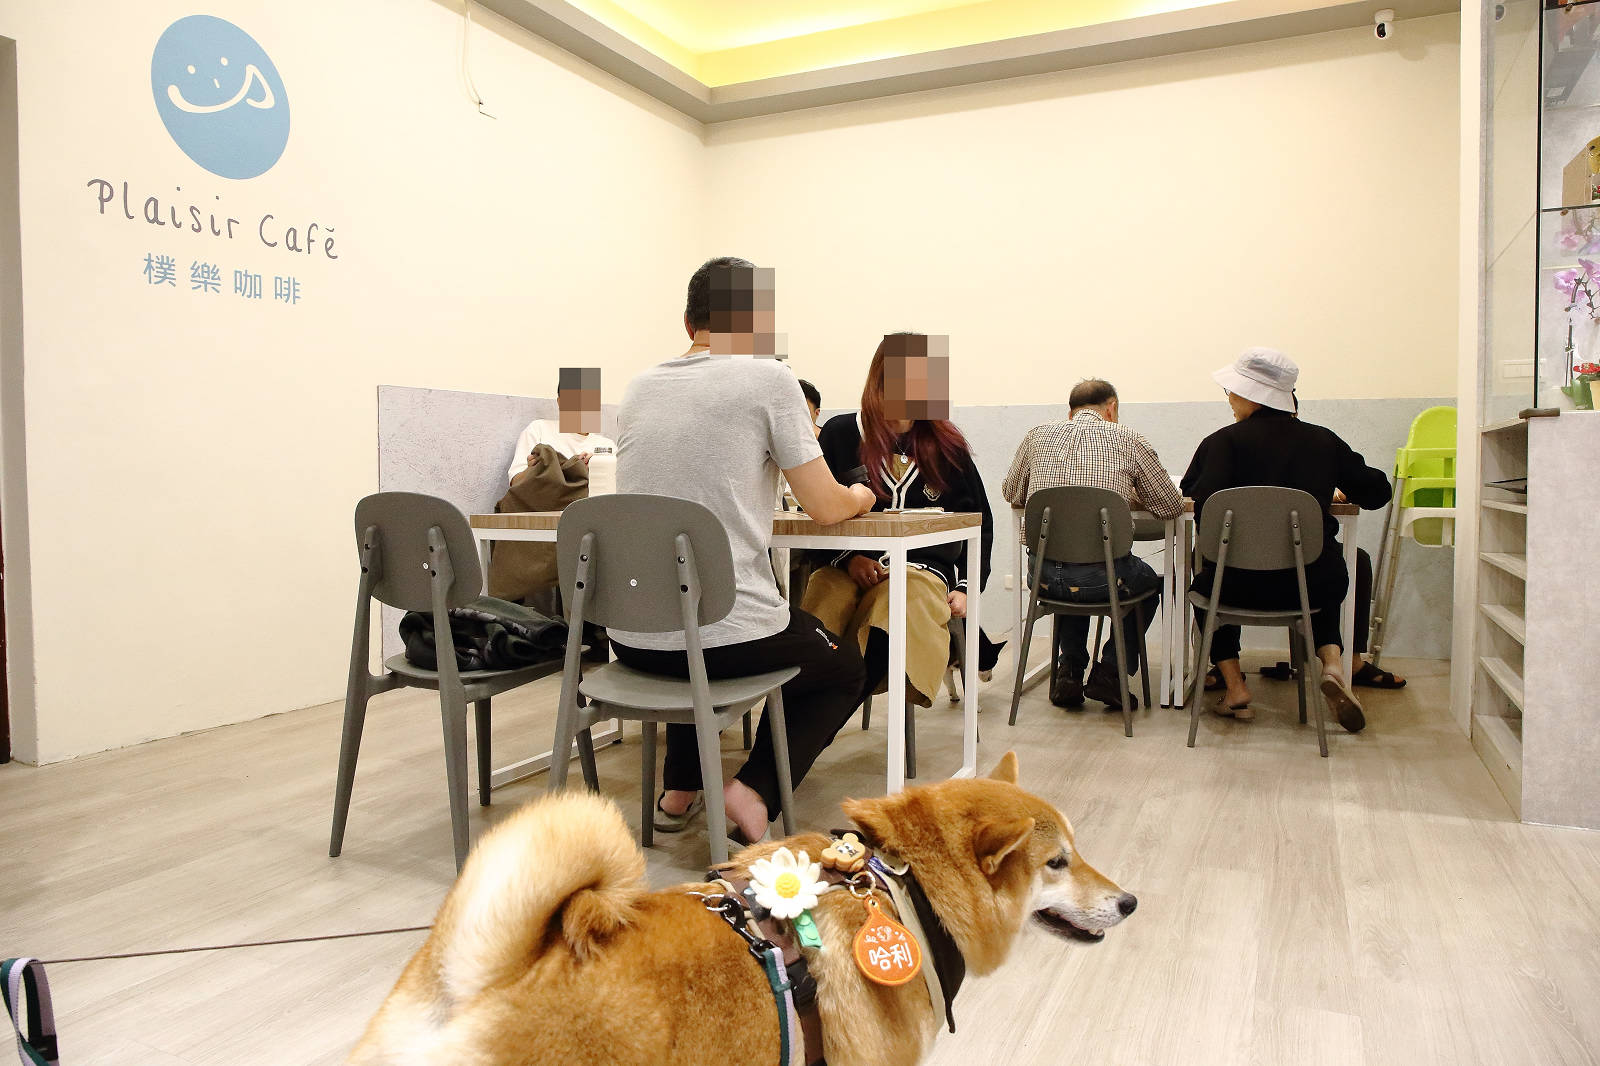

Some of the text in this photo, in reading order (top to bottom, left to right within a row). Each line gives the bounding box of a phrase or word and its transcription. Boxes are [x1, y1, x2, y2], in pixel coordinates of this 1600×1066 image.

[87, 178, 240, 239] Plaisir
[143, 252, 301, 305] 樸樂咖啡
[868, 942, 913, 970] 哈利
